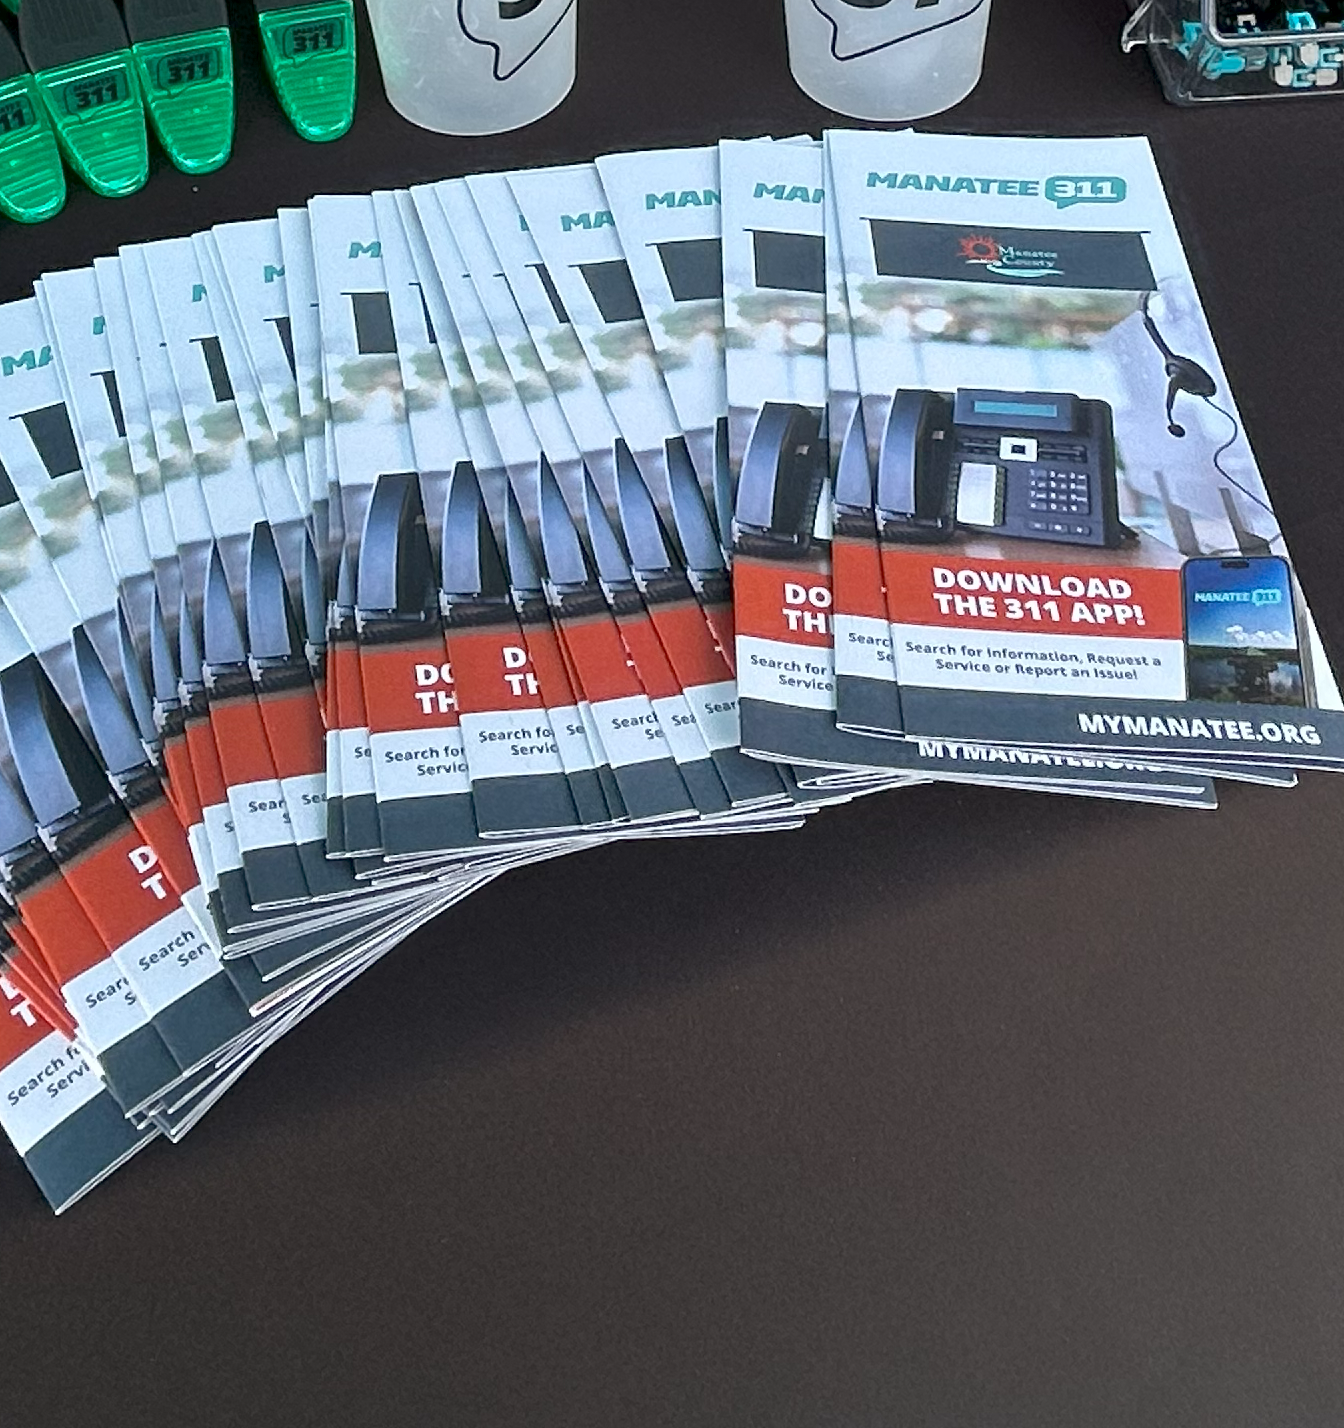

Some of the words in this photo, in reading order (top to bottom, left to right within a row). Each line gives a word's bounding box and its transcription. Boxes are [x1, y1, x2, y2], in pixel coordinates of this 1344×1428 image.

[294, 32, 334, 53] 311
[168, 61, 210, 84] 311
[75, 83, 118, 108] 311
[866, 172, 1039, 197] MANATEE
[1053, 180, 1118, 199] 311
[932, 567, 1132, 600] DOWNLOAD
[782, 608, 827, 634] TH
[933, 593, 998, 619] THE
[1004, 598, 1061, 622] 311
[1071, 602, 1146, 626] APP!
[848, 632, 892, 648] Searc
[750, 654, 801, 672] Search
[805, 663, 828, 676] for
[906, 641, 956, 657] Search
[960, 645, 983, 659] for
[987, 647, 1083, 665] Information,
[1087, 652, 1148, 668] Request
[1152, 657, 1162, 667] a
[935, 658, 991, 673] Service
[995, 664, 1011, 675] or
[1015, 663, 1067, 679] Report
[1071, 668, 1090, 679] an
[1093, 668, 1138, 681] Issue!
[504, 672, 541, 696] TH
[778, 674, 834, 691] Service
[414, 691, 460, 714] TH
[704, 700, 737, 715] Sear
[611, 711, 659, 730] Searc
[1078, 712, 1322, 746] MYMANATEE.ORG
[478, 726, 532, 743] Search
[536, 726, 555, 739] fo
[384, 746, 439, 763] Search
[510, 742, 559, 756] Servic
[417, 760, 469, 777] Servic
[248, 799, 286, 814] Sear
[138, 930, 196, 972] Search
[85, 977, 129, 1009] Sear
[7, 1057, 65, 1107] Search
[46, 1059, 90, 1099] Servi
